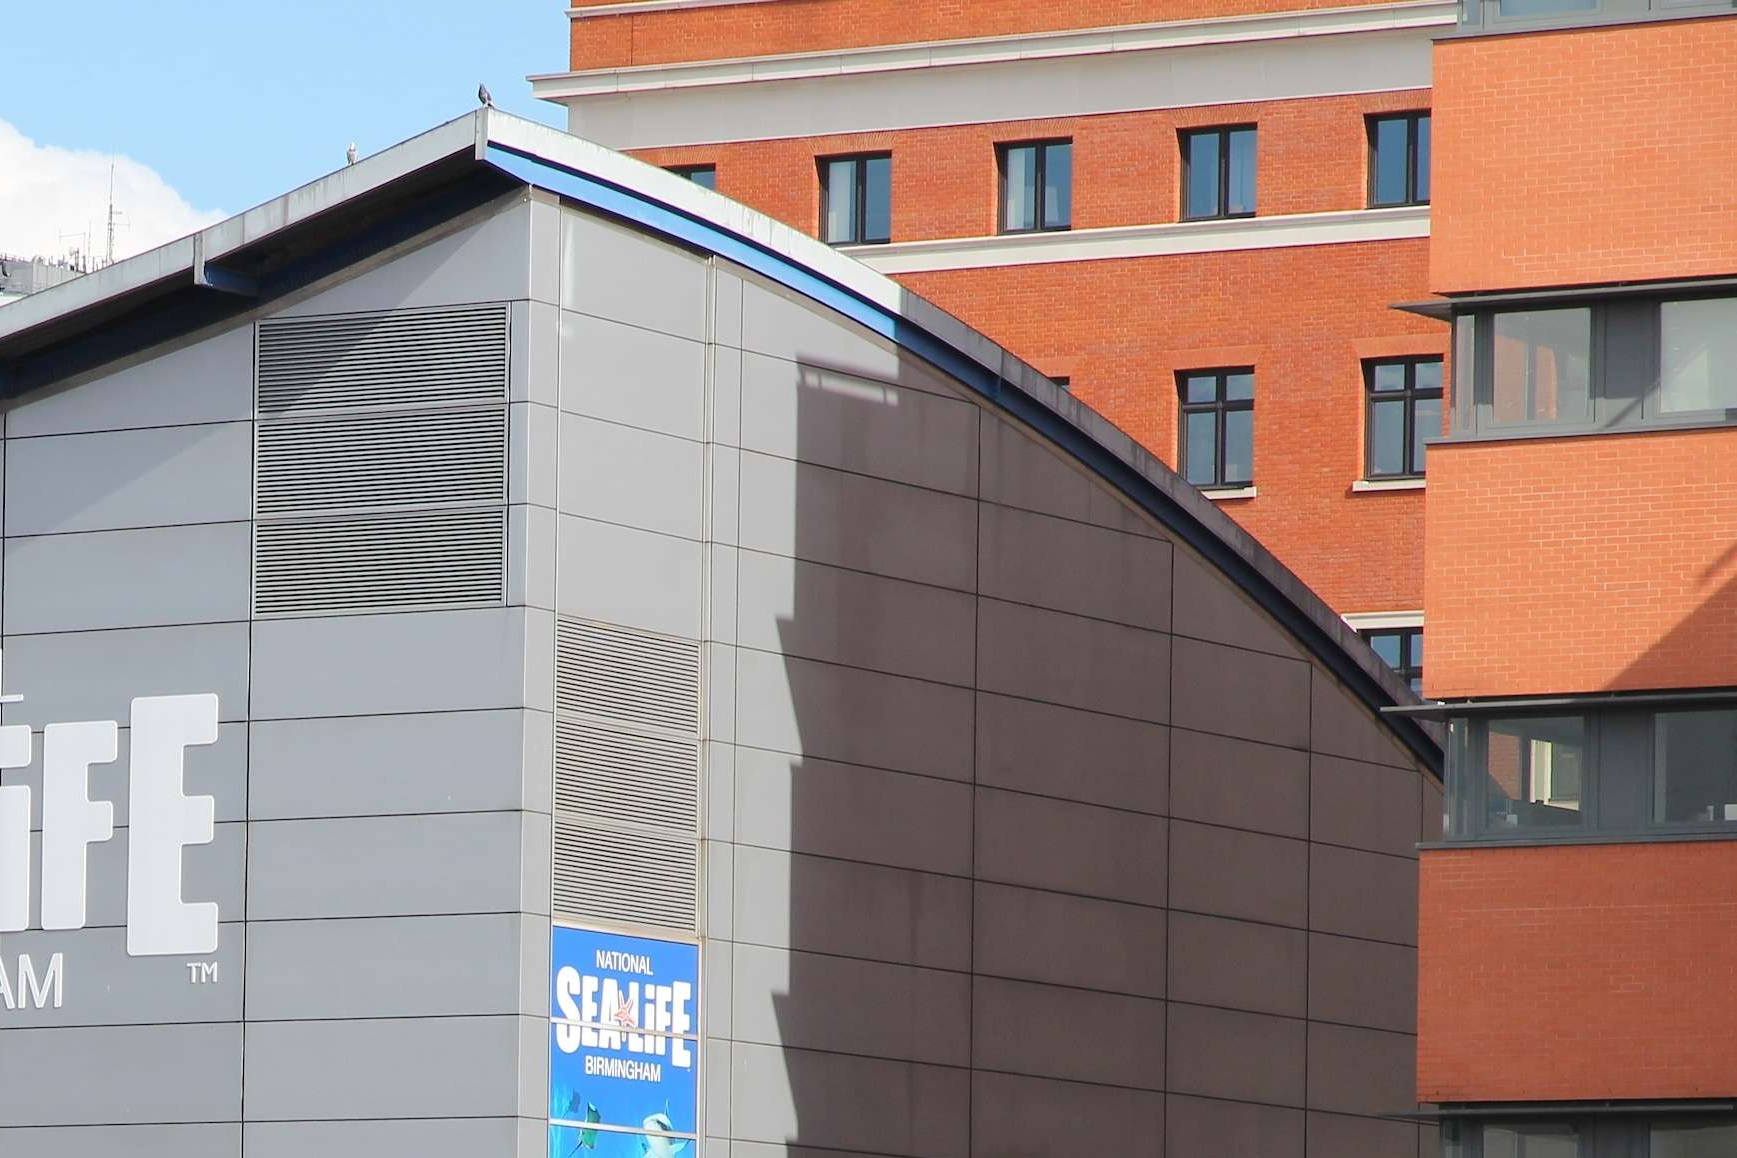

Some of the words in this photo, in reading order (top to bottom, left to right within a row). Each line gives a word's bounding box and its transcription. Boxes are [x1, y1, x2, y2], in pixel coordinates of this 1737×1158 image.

[186, 961, 218, 983] TM
[596, 949, 654, 975] NATIONAL
[585, 1055, 661, 1082] BIRMINGHAM
